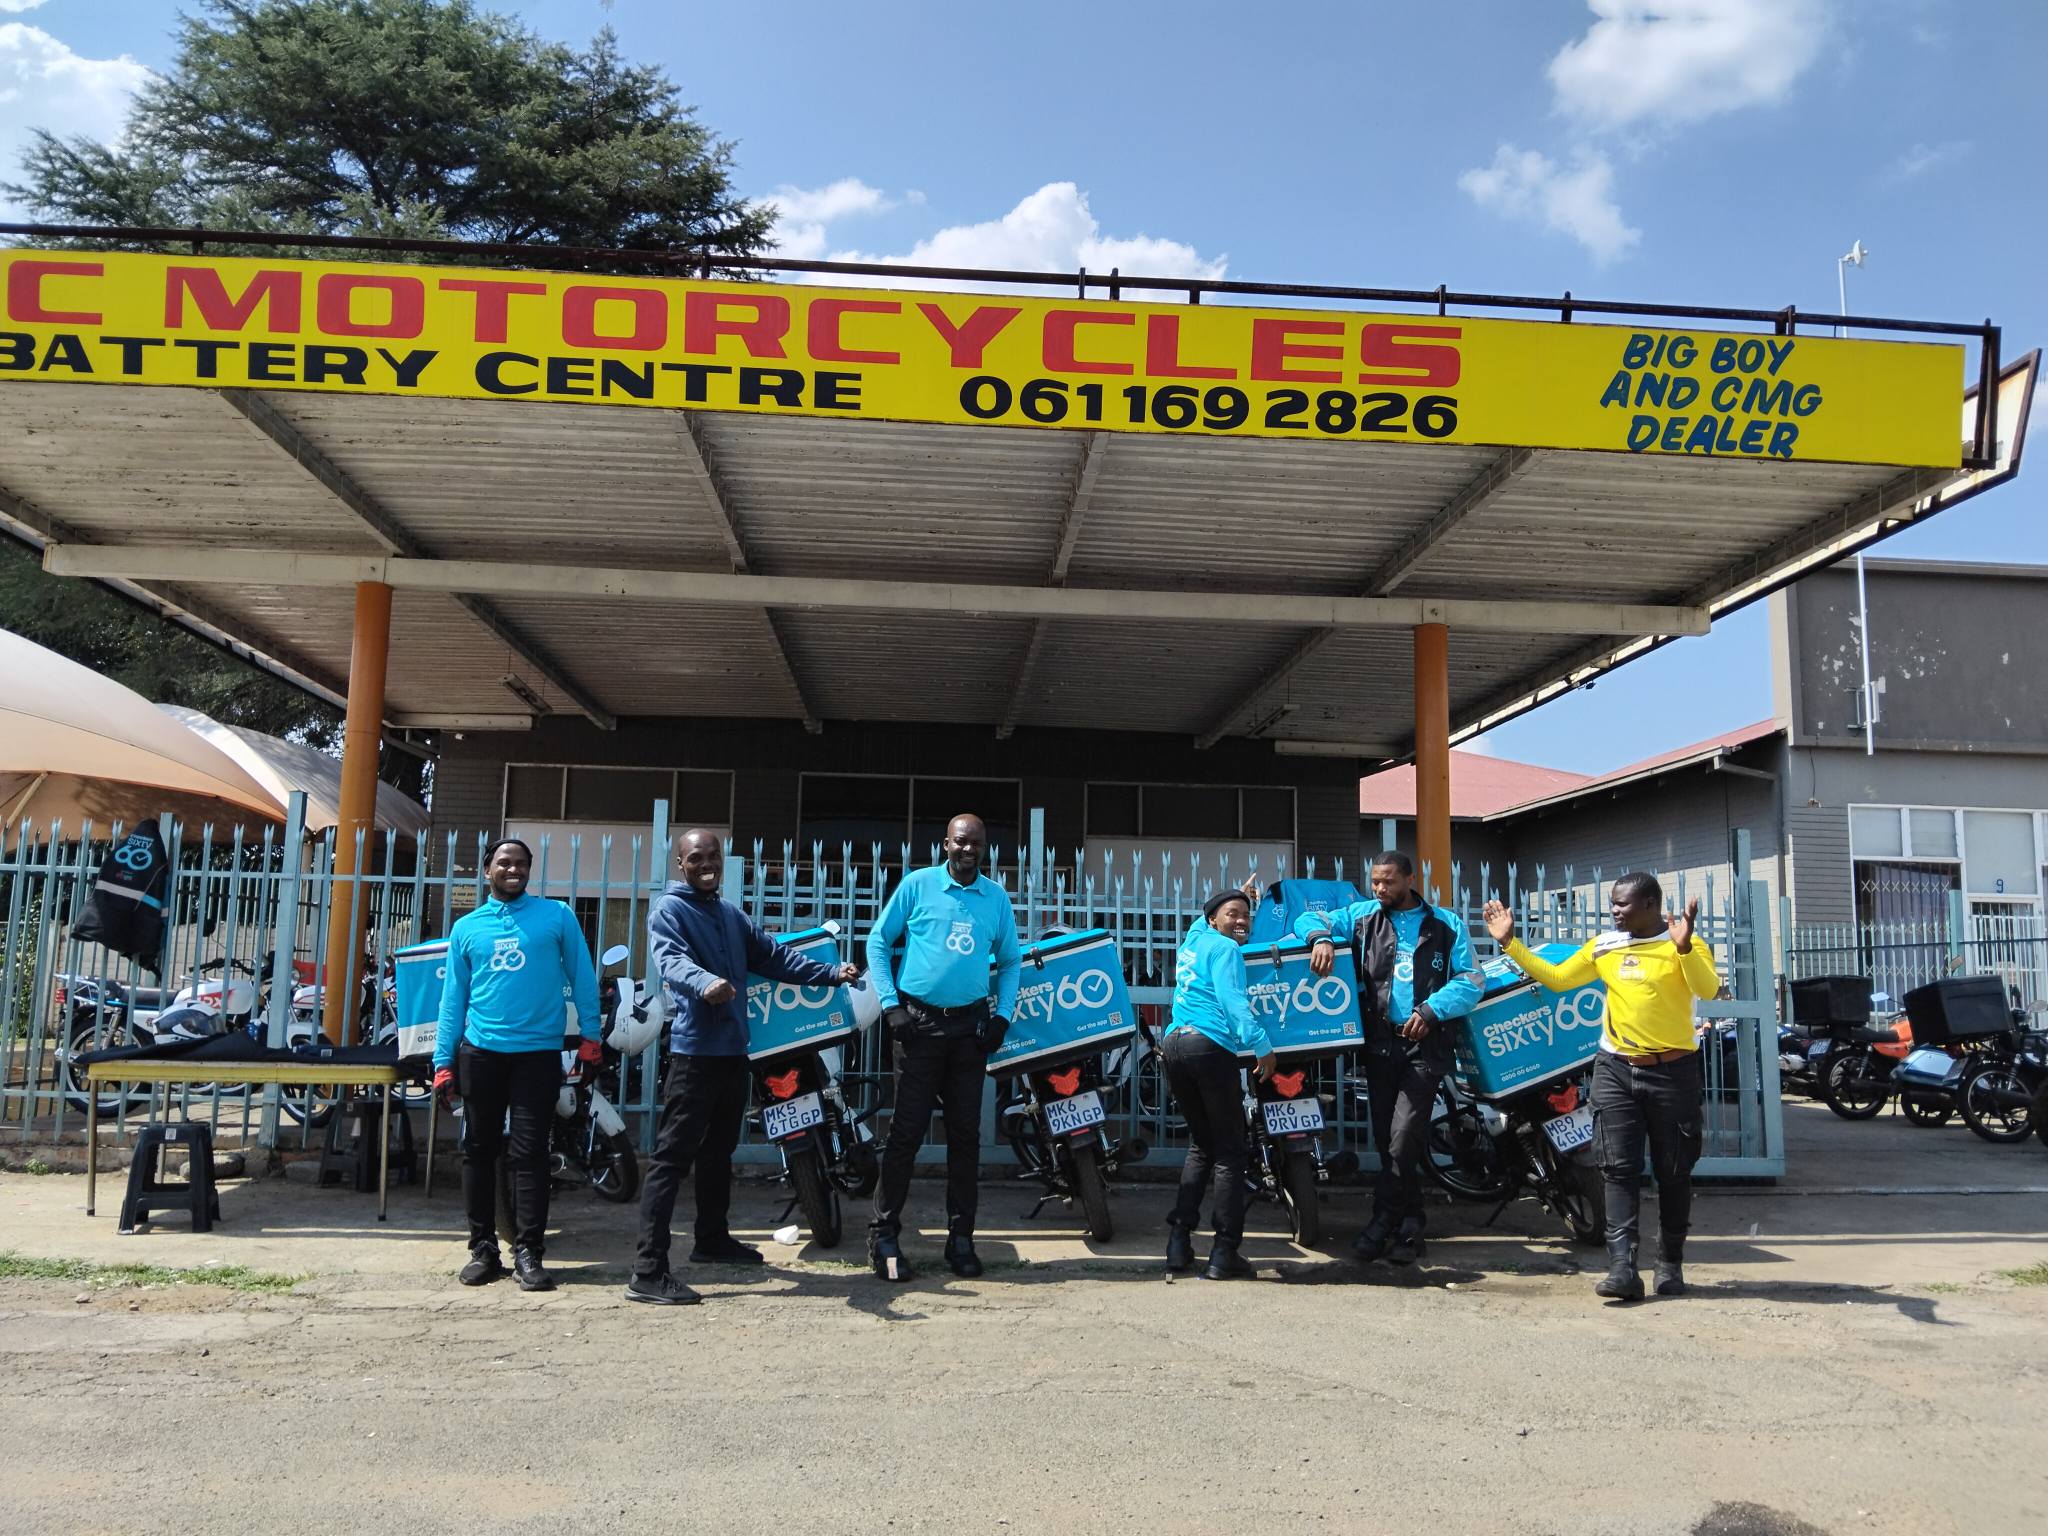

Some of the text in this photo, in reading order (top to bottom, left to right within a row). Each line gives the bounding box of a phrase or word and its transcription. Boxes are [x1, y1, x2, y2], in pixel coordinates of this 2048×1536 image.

[8, 260, 1462, 388] C MOTORCYCLES
[0, 331, 862, 411] BATTERY CENTRE
[1622, 333, 1795, 376] BIG BOY
[1599, 371, 1824, 417] AND CMG
[1626, 414, 1800, 461] DEALER
[1996, 878, 2004, 894] 9
[1057, 969, 1114, 1010] 60
[1246, 982, 1291, 996] ckers
[1292, 976, 1351, 1016] 60
[1483, 1005, 1552, 1038] Checkers
[1555, 987, 1606, 1031] 60
[765, 1101, 797, 1123] MK5
[1046, 1099, 1077, 1119] MK6
[1264, 1102, 1296, 1118] MK6
[1545, 1115, 1575, 1137] MB9
[1556, 1123, 1593, 1148] 4GWG
